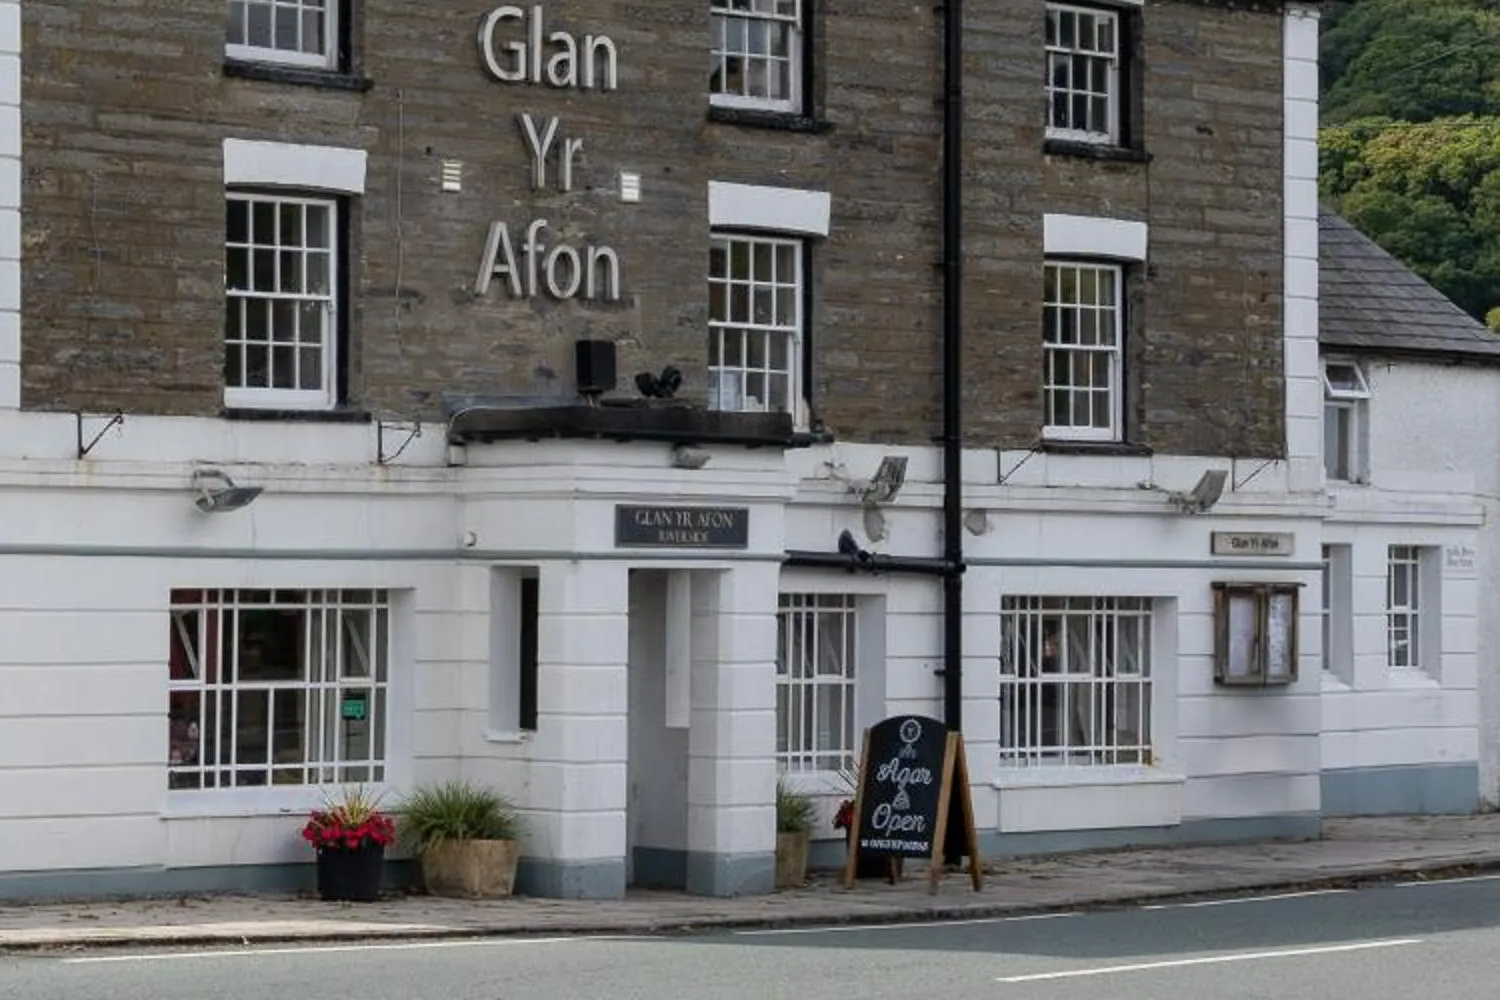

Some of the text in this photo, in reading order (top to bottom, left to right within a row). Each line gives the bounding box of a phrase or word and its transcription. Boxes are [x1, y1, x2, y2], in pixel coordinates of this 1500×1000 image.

[479, 4, 618, 90] Glan
[519, 111, 583, 192] Yr
[475, 218, 620, 300] Afon
[635, 510, 733, 529] GLAN YR AFON
[876, 757, 933, 791] Agor
[871, 803, 926, 836] Open
